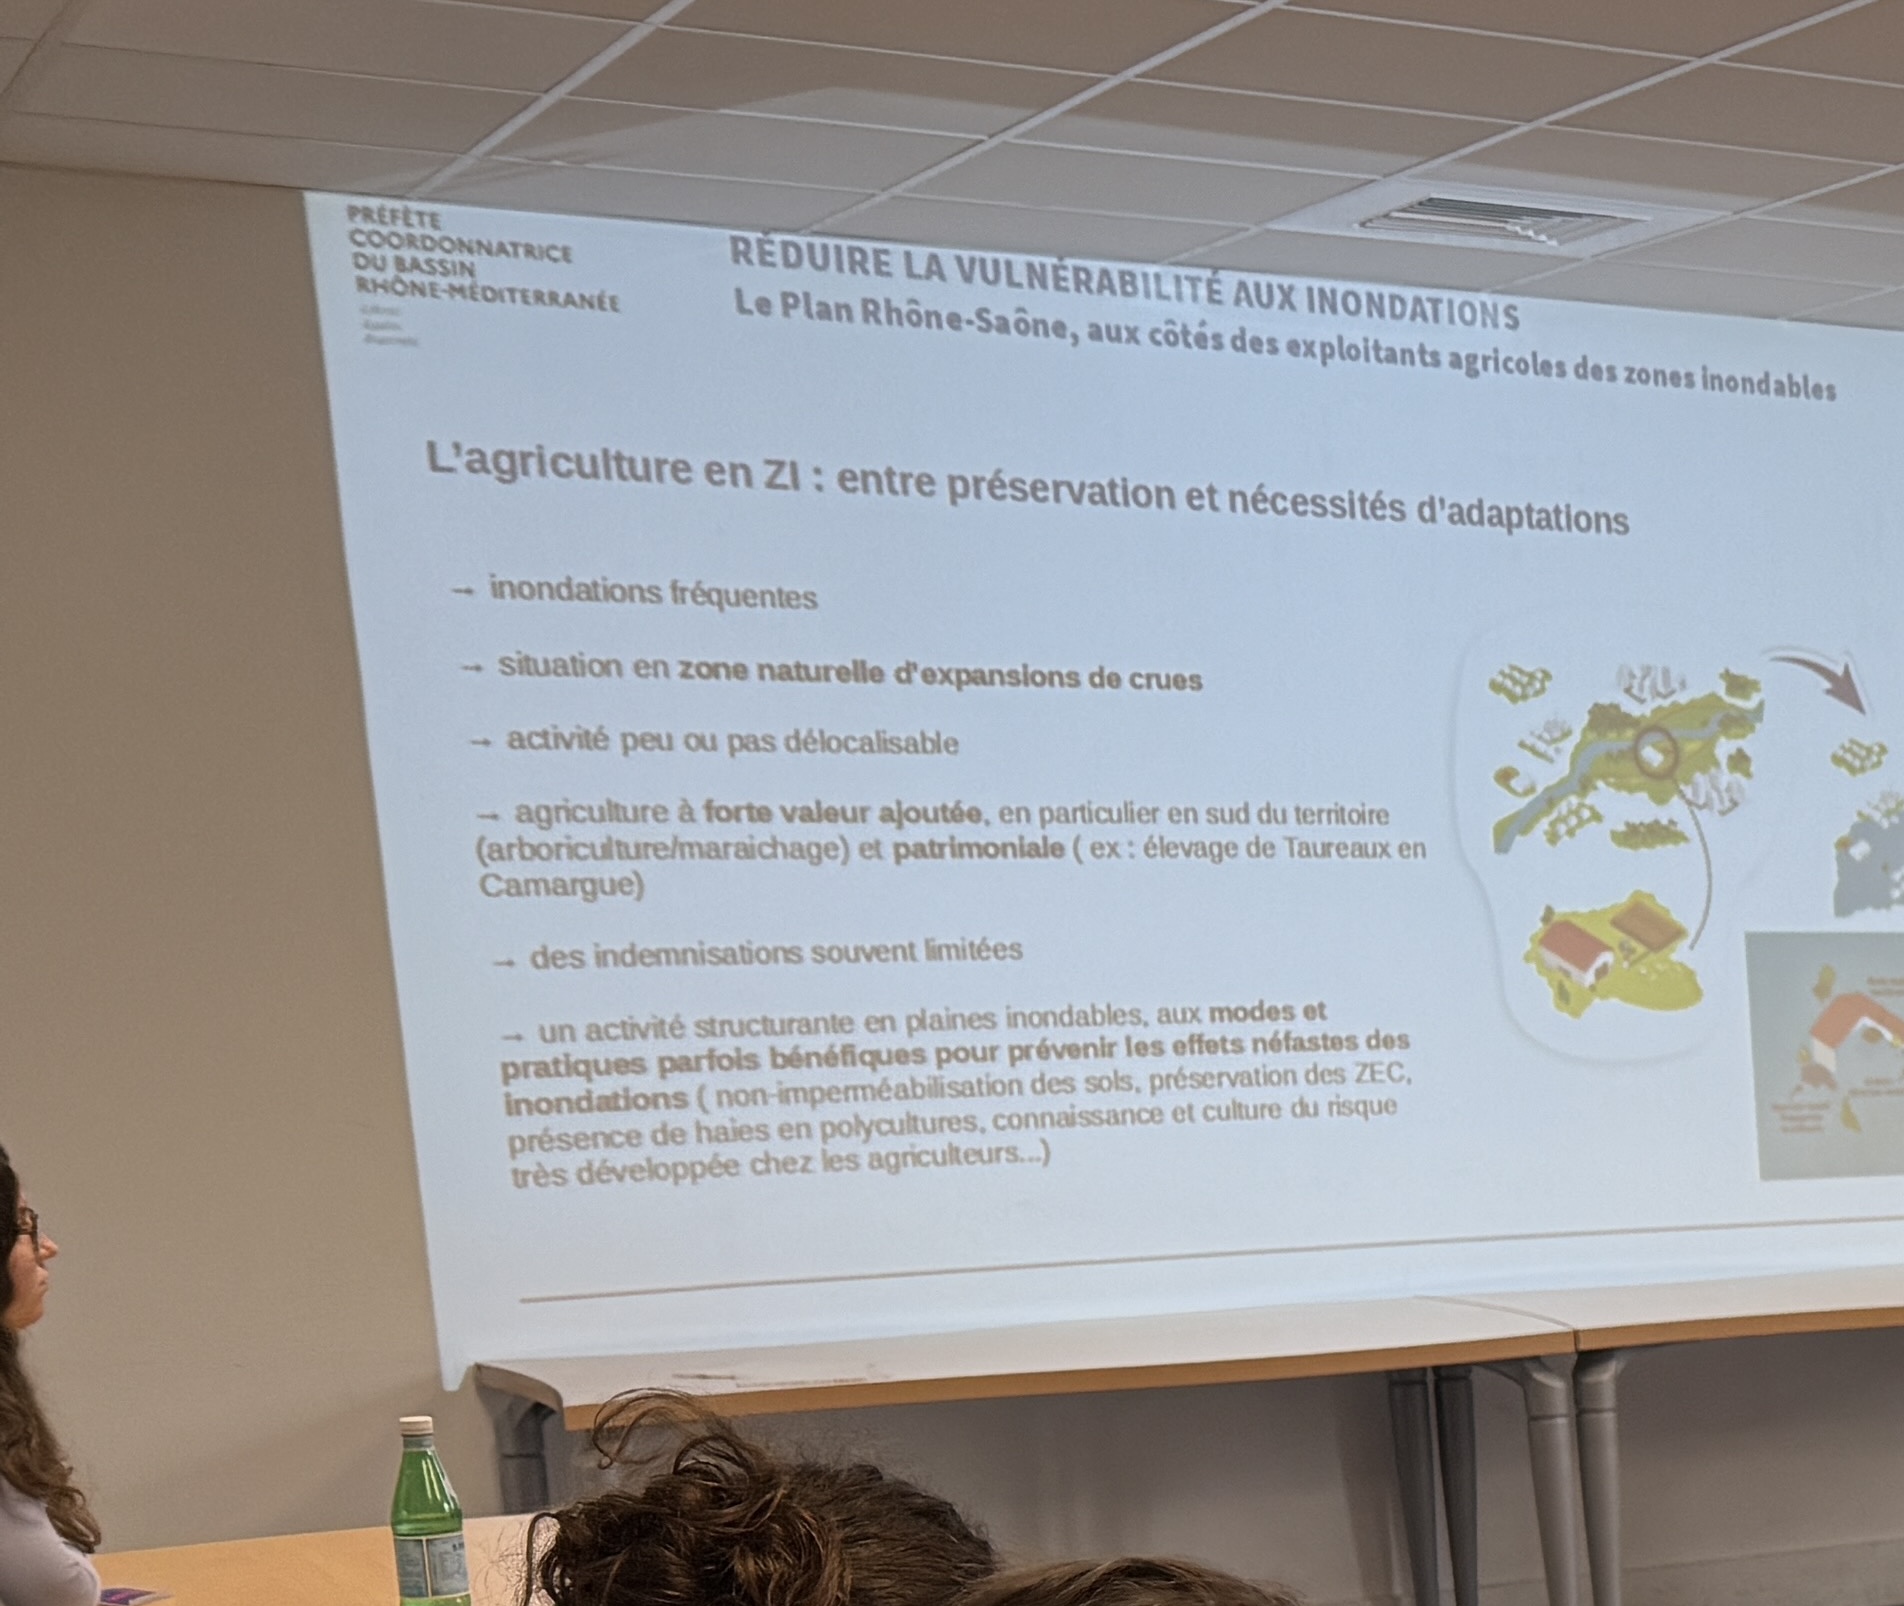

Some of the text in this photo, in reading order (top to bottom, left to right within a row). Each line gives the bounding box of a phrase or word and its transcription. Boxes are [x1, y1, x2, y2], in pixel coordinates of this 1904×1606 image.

[347, 205, 441, 230] PRÉFÈTE
[349, 228, 573, 264] COORDONNATRICE
[353, 252, 476, 279] DU BASSIN
[356, 274, 619, 313] RHÔNE-MÉDITERRANÉE
[730, 231, 1520, 330] RÉDUIRE LA VULNÉRABILITÉ AUX INONDATIONS
[735, 287, 1836, 401] Le Plan Rhône-Saône, aux côtés des exploitants agricoles des zones inondables
[704, 461, 753, 488] en
[764, 459, 800, 491] ZI
[837, 466, 936, 497] entre
[947, 468, 1176, 510] préservation
[1186, 483, 1220, 512] et
[1229, 483, 1407, 522] nécessités
[1417, 495, 1630, 536] d'adaptations
[490, 574, 818, 613] inondations fréquentes
[499, 651, 623, 678] situation
[633, 659, 670, 678] en
[678, 660, 749, 681] zone
[757, 659, 885, 684] naturelle
[1089, 665, 1122, 689] de
[1129, 671, 1204, 692] crues
[508, 725, 959, 758] activité peu ou pas délocalisable
[516, 798, 1389, 831] agriculture à forte valeur ajoutée, en particulier en sud du territoire
[859, 839, 883, 860] et
[893, 835, 1065, 866] patrimoniale
[1090, 842, 1121, 859] ex
[1144, 835, 1238, 864] élevage
[1246, 835, 1275, 858] de
[1284, 837, 1391, 859] Taureaux
[1398, 842, 1426, 859] en
[480, 870, 644, 903] Camargue)
[531, 937, 1023, 969] des indemnisations souvent limitées
[539, 999, 1327, 1043] un activité structurante en plaines inondables, aux modes et
[501, 1029, 1410, 1086] pratiques parfois bénéfiques pour prévenir les effets néfastes des
[504, 1087, 689, 1116] inondations
[1031, 1072, 1076, 1095] des
[1085, 1069, 1141, 1093] sols,
[1149, 1064, 1297, 1097] préservation
[1305, 1062, 1346, 1085] des
[1355, 1061, 1411, 1084] ZEC,
[509, 1094, 1397, 1160] présence de haies en polycultures, connaissance et culture du risque
[512, 1162, 568, 1189] très
[576, 1153, 740, 1186] développée
[750, 1151, 812, 1175] chez
[822, 1149, 860, 1172] les
